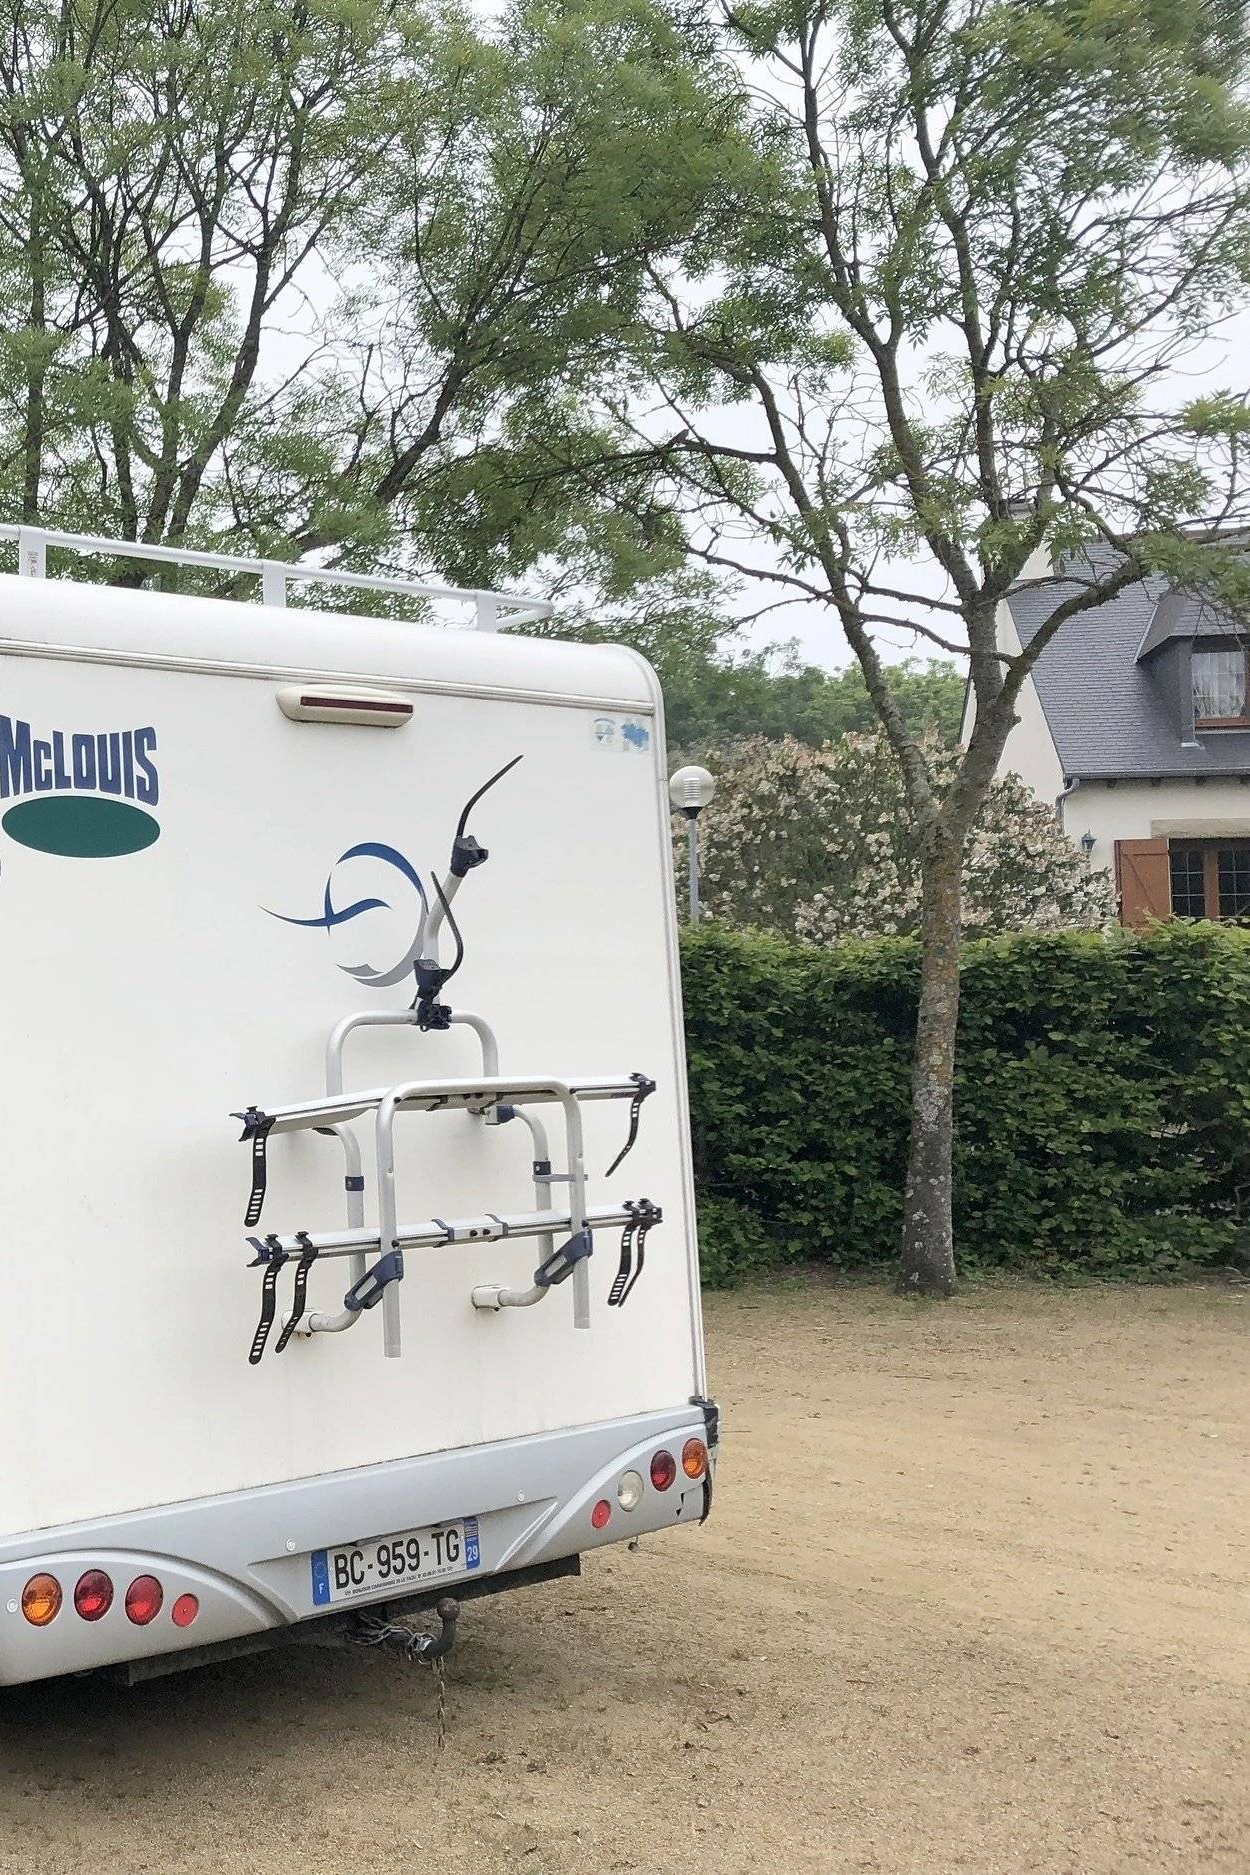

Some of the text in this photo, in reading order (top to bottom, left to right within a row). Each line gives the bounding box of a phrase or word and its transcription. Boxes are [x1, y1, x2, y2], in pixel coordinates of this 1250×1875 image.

[334, 1529, 459, 1589] BC-959-TG
[466, 1545, 478, 1561] 29
[318, 1583, 324, 1595] F
